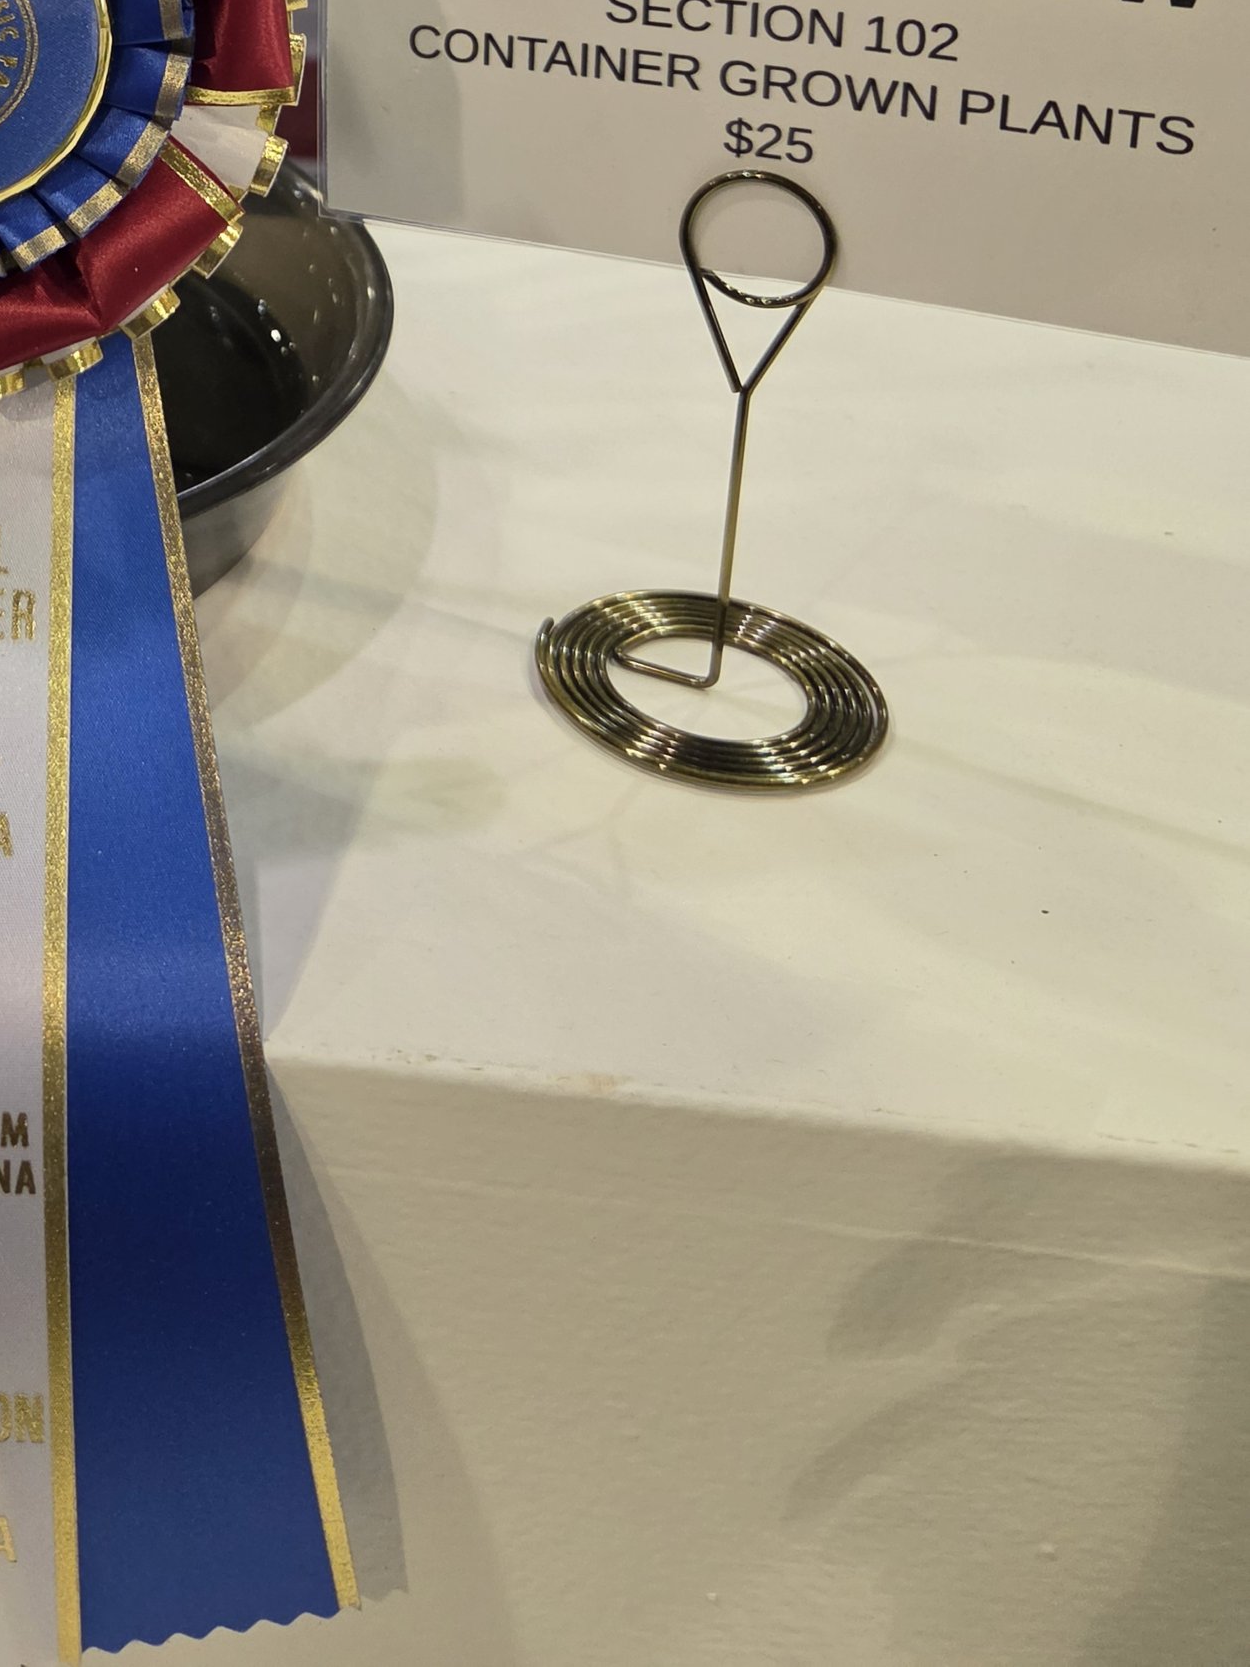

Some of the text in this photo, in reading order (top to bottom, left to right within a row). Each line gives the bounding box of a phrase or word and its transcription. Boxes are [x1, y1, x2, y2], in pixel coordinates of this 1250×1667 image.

[866, 15, 961, 62] 102
[407, 24, 1197, 156] CONTAINER GROWN PLANTS
[723, 117, 815, 165] $25
